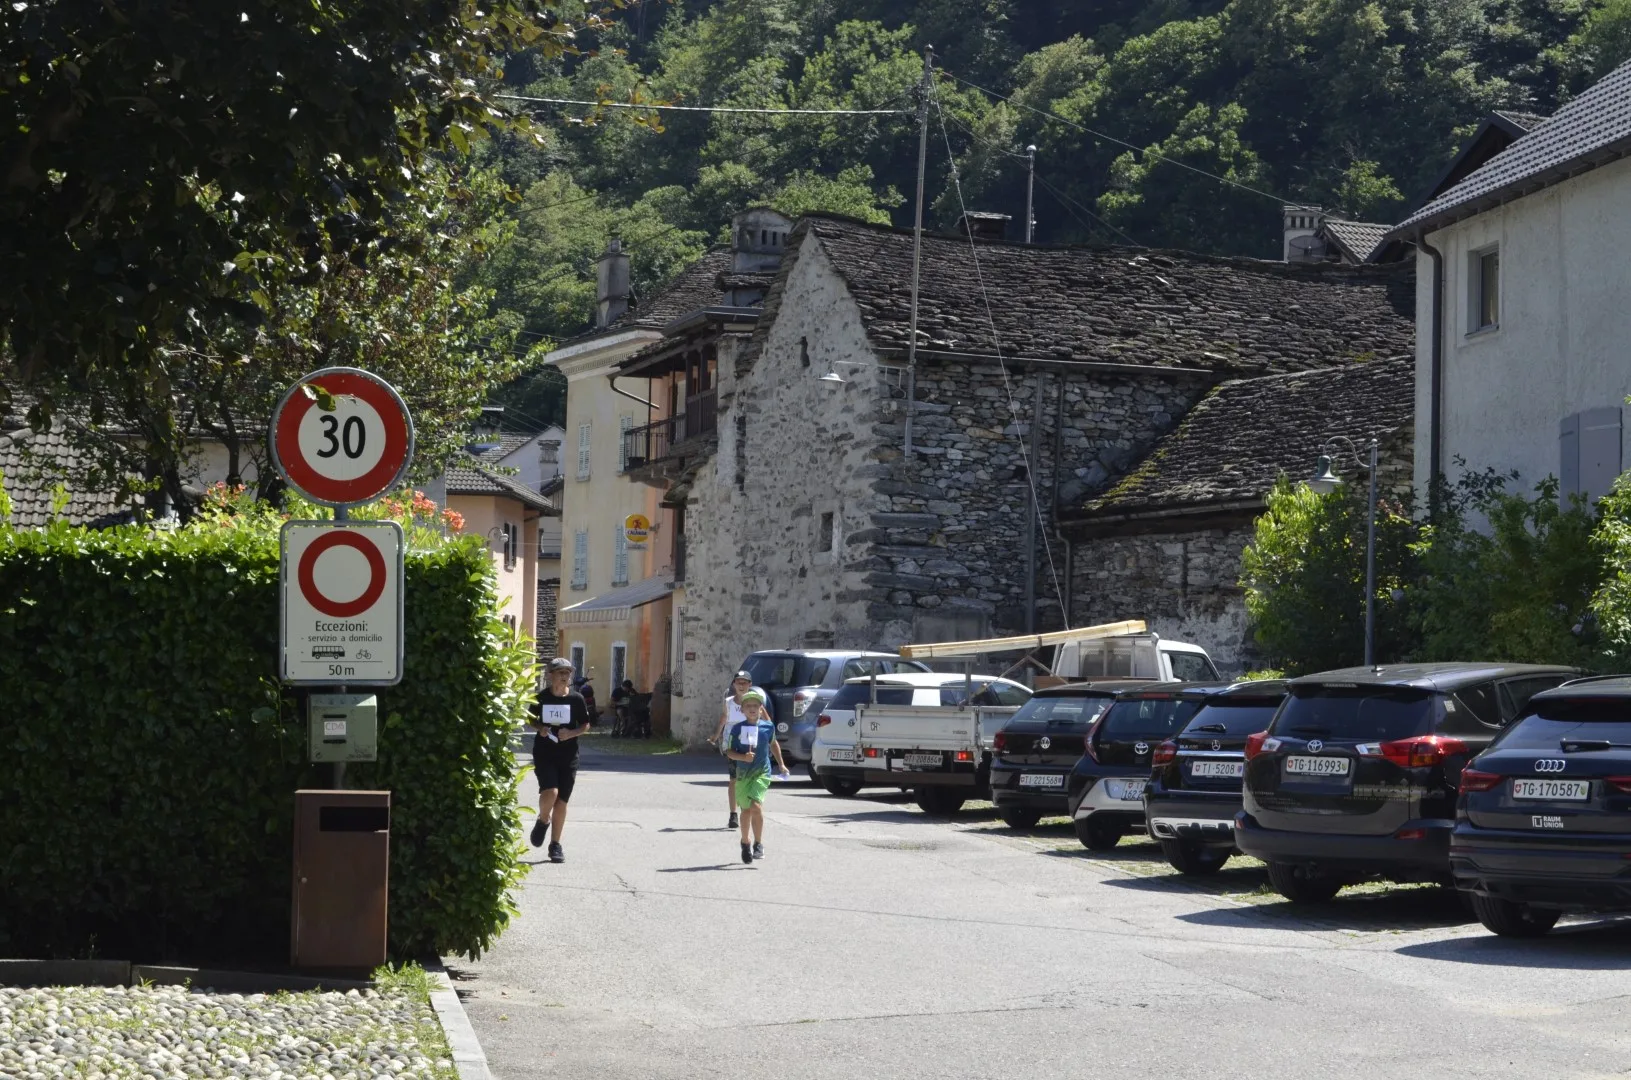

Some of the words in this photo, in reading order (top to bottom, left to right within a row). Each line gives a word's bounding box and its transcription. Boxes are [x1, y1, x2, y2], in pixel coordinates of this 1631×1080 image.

[316, 414, 366, 459] 30
[315, 620, 368, 632] Eccezioni:
[308, 634, 337, 642] servizio
[349, 633, 382, 642] domicilio
[328, 664, 342, 676] 50
[344, 666, 355, 676] m
